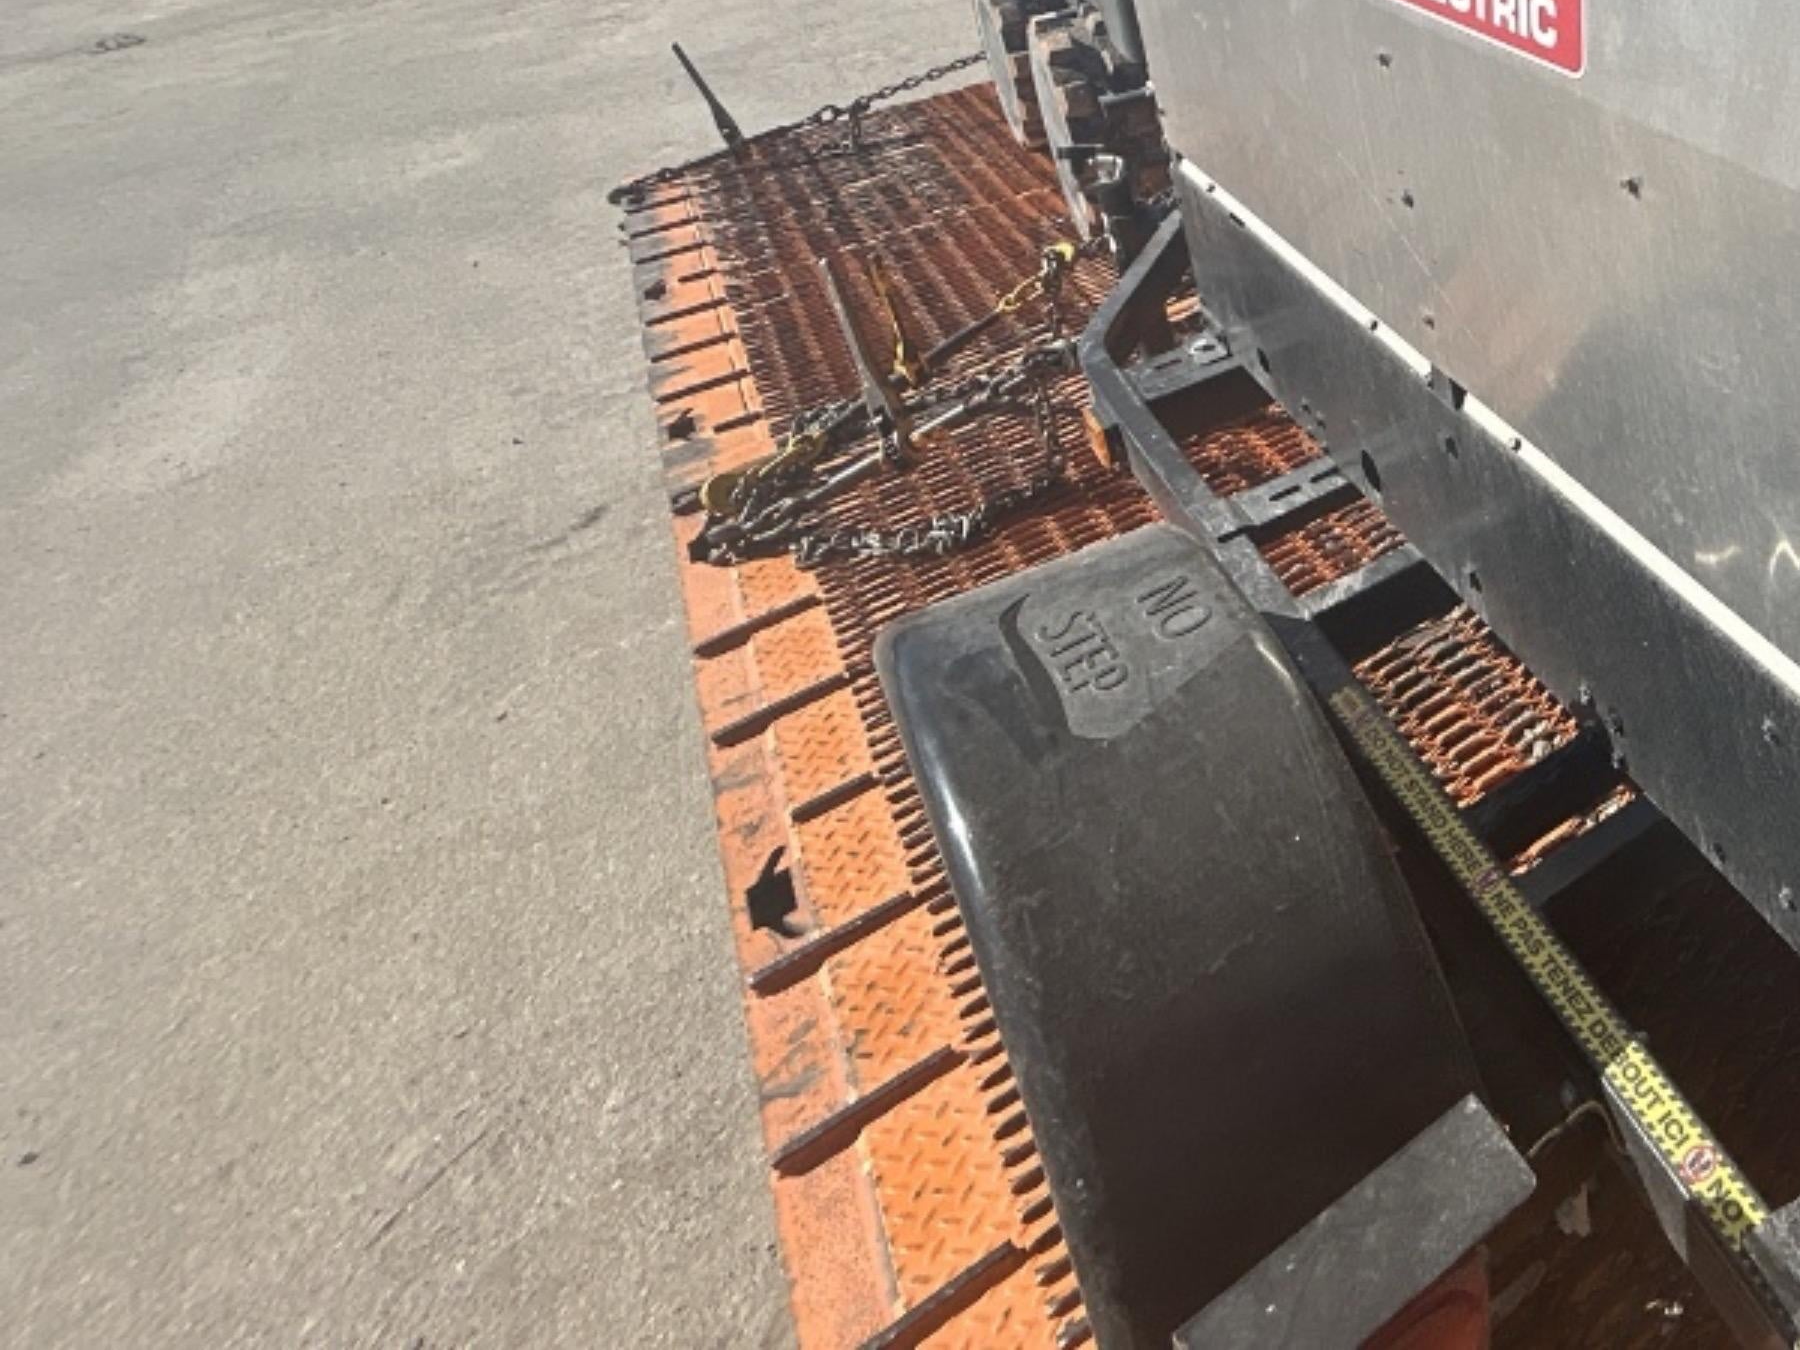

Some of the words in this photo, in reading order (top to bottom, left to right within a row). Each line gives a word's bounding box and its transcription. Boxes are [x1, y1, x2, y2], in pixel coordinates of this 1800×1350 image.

[1134, 574, 1212, 640] NO
[1039, 610, 1130, 693] STEP
[1403, 777, 1447, 829] STAND
[1509, 916, 1547, 958] PAS
[1541, 952, 1595, 1022] TENEZ
[1587, 1018, 1666, 1111] DEBOUT
[1657, 1110, 1690, 1150] ICI
[1706, 1177, 1745, 1223] NO
